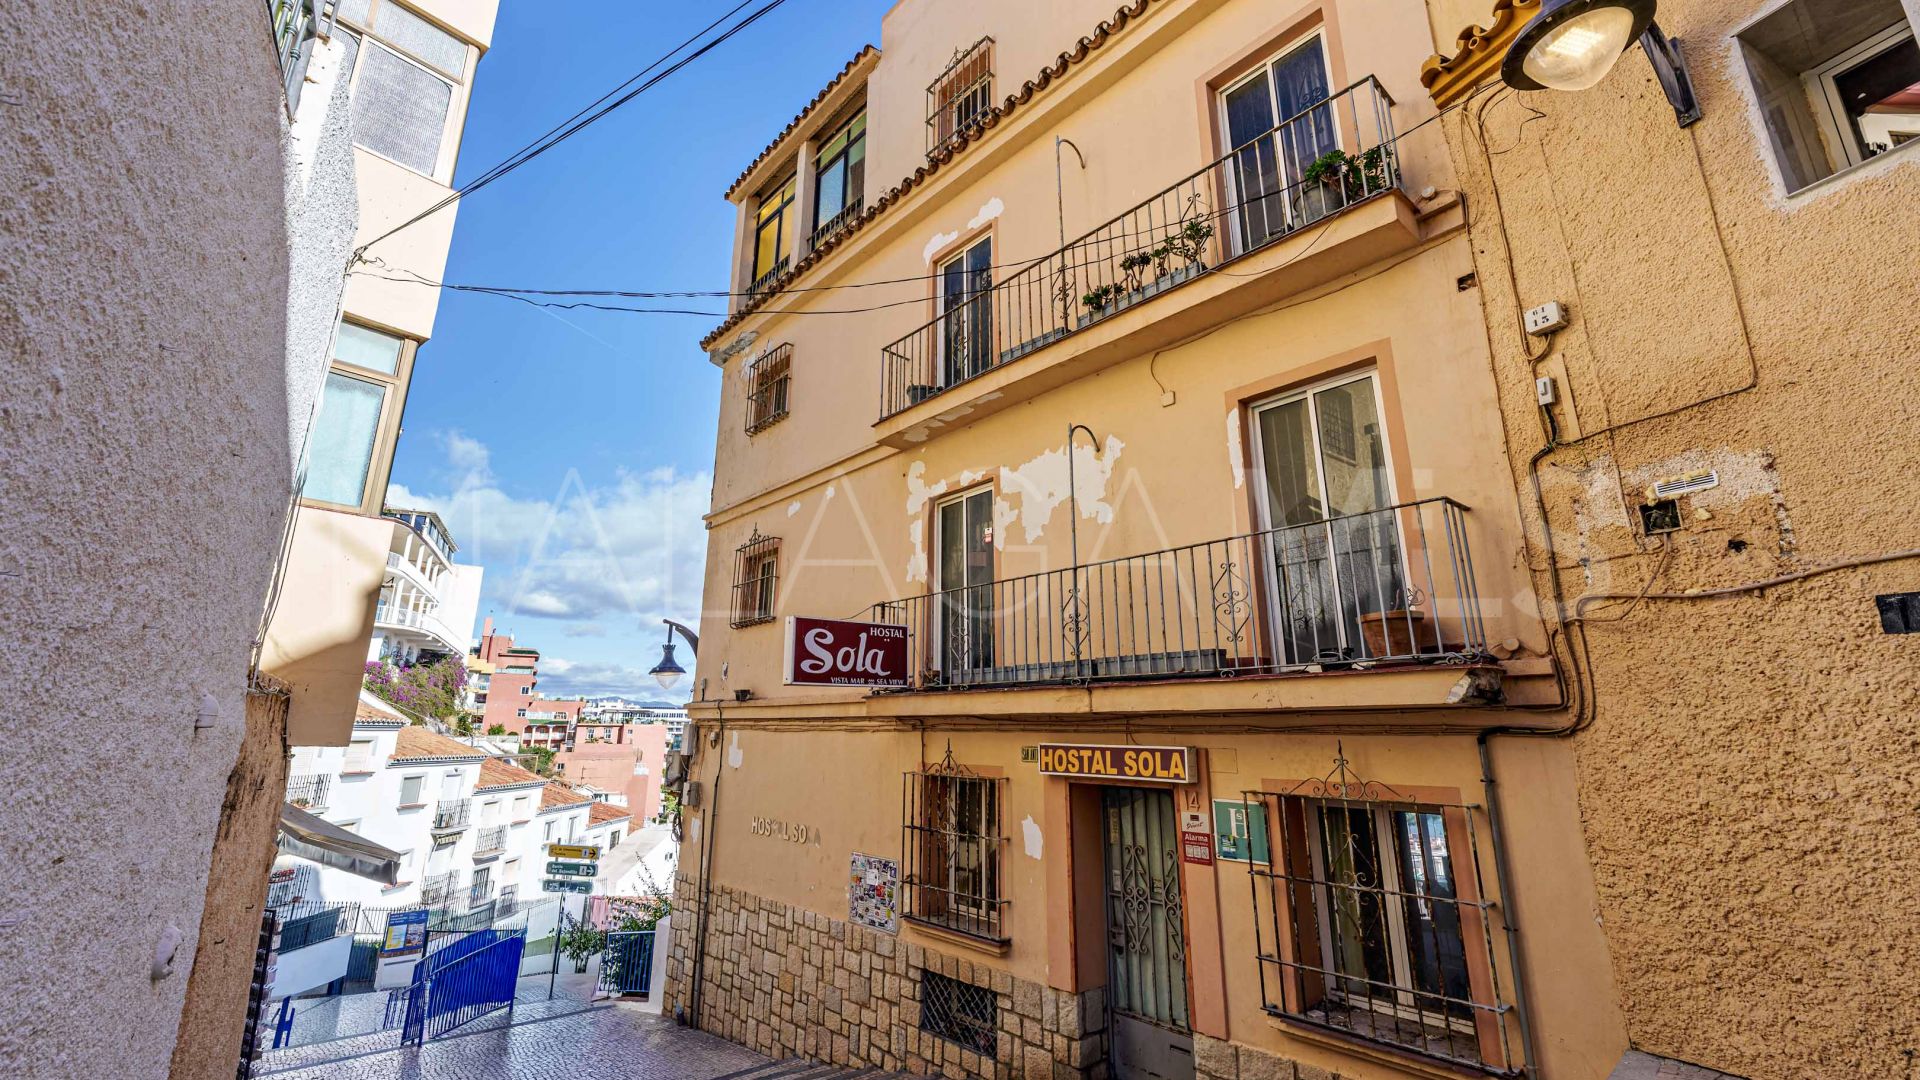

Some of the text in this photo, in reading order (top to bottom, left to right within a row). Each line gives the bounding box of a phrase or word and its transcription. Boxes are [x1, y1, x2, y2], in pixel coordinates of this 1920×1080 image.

[870, 627, 904, 638] HOSTAL
[800, 628, 891, 676] Sola
[830, 676, 849, 685] VISTA
[850, 677, 865, 685] MAR
[876, 678, 888, 686] SEA
[1041, 748, 1186, 779] HOSTAL SOLA
[752, 816, 790, 841] HOSL
[1185, 833, 1208, 842] Alarma
